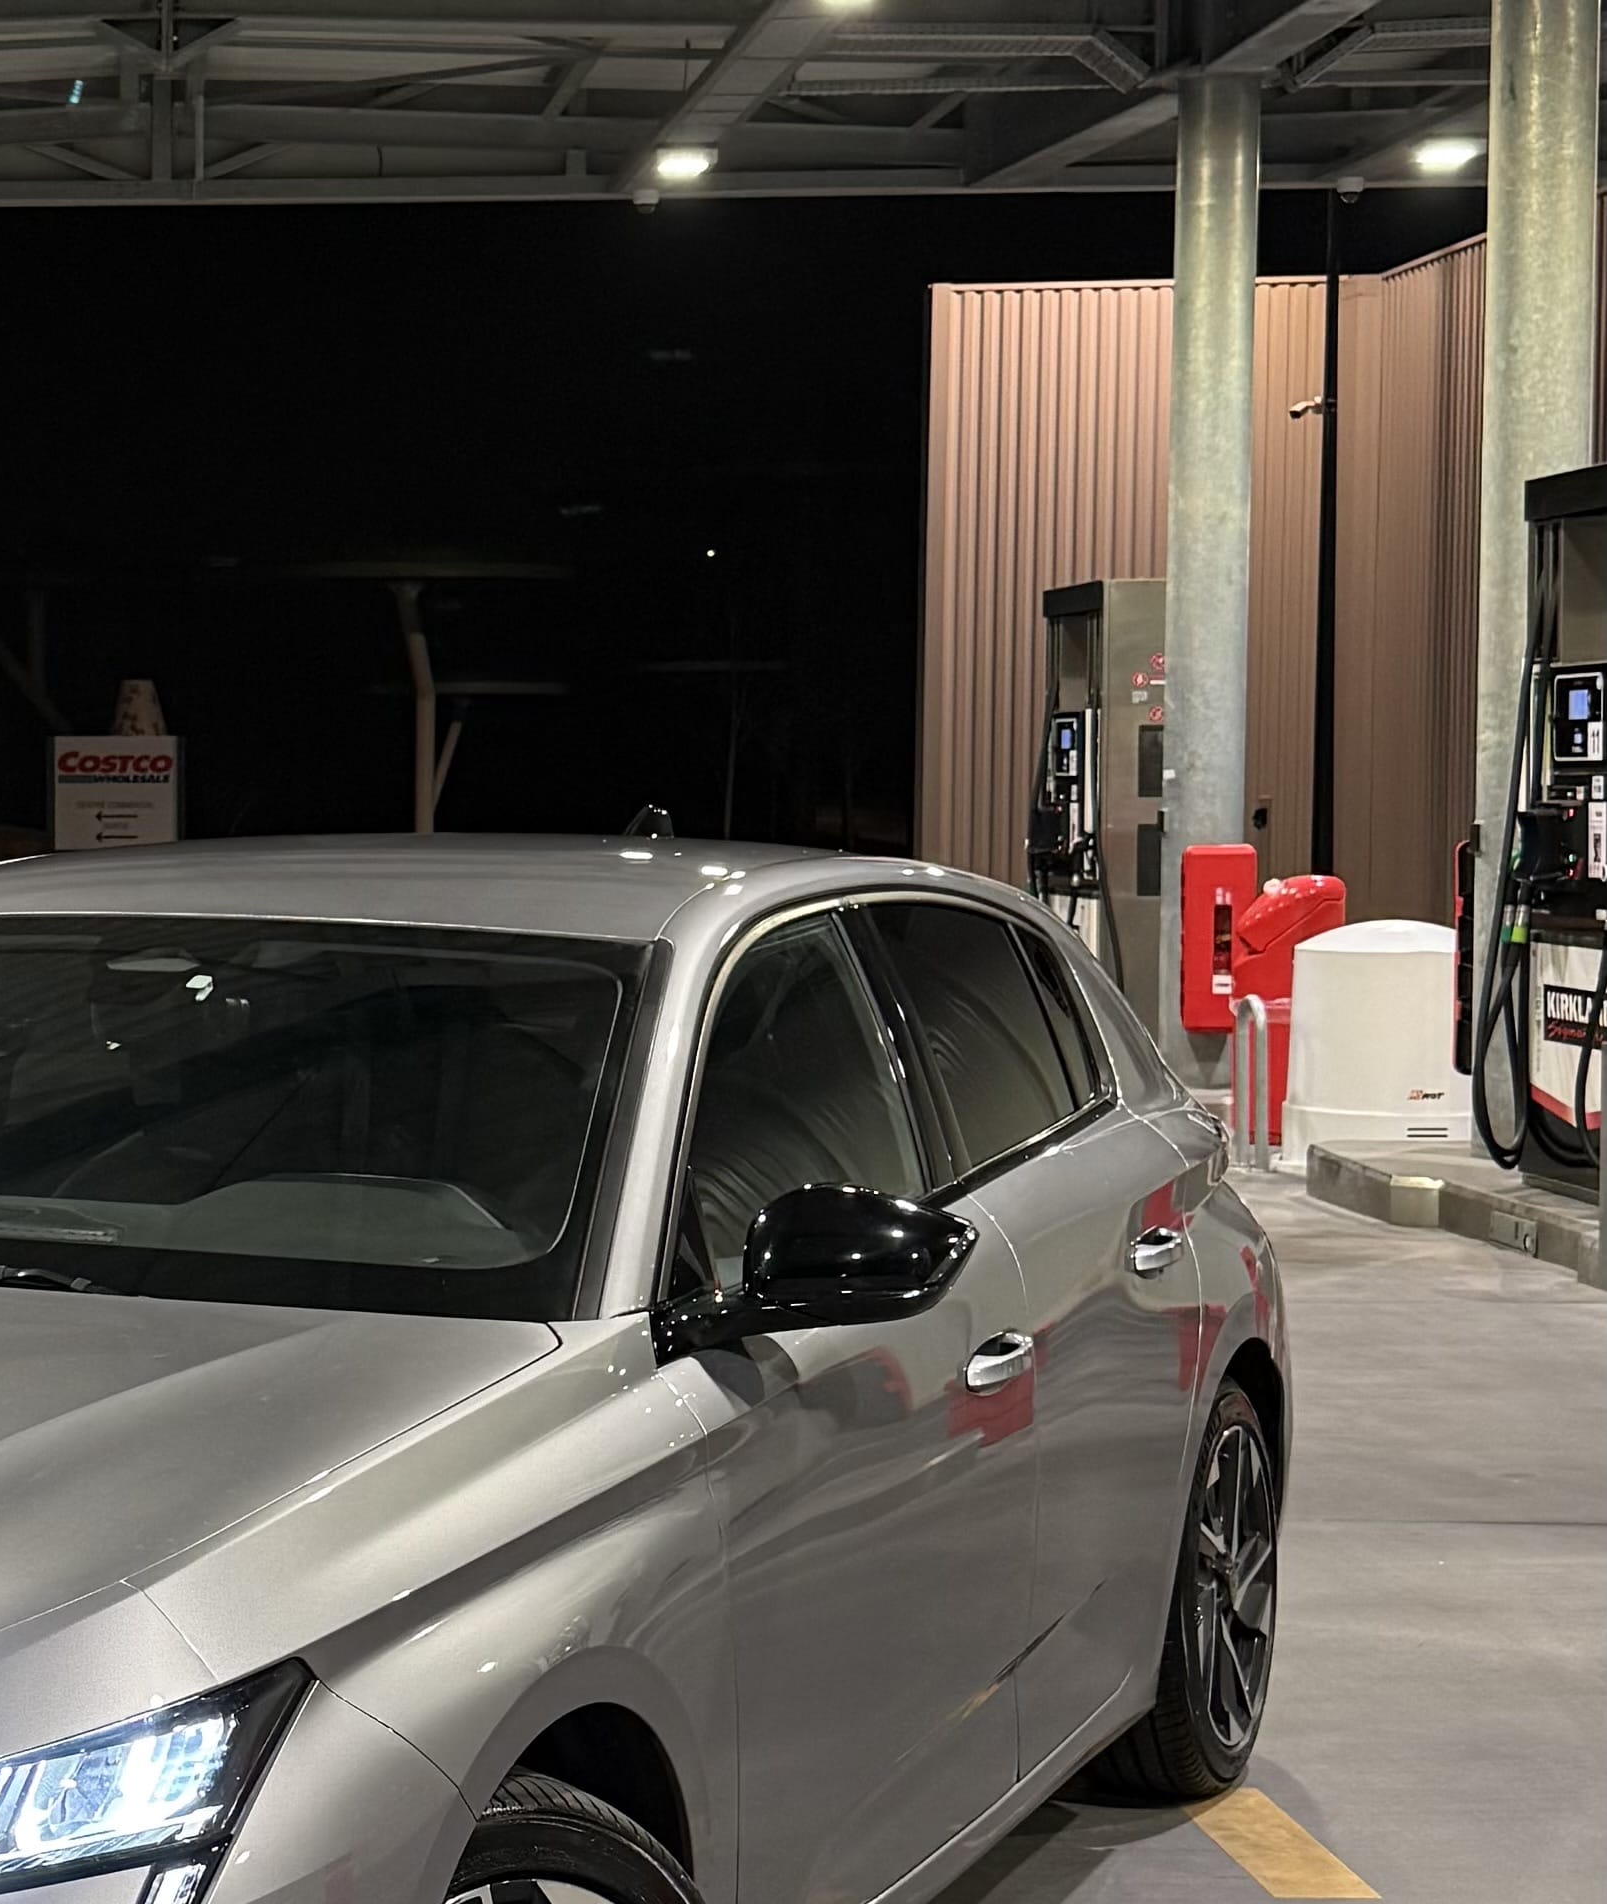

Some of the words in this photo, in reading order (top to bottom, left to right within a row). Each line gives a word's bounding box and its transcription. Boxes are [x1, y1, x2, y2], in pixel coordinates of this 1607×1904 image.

[58, 751, 172, 773] COSTCO
[94, 775, 169, 784] WHOLESALE
[1546, 991, 1607, 1027] KIRKLA
